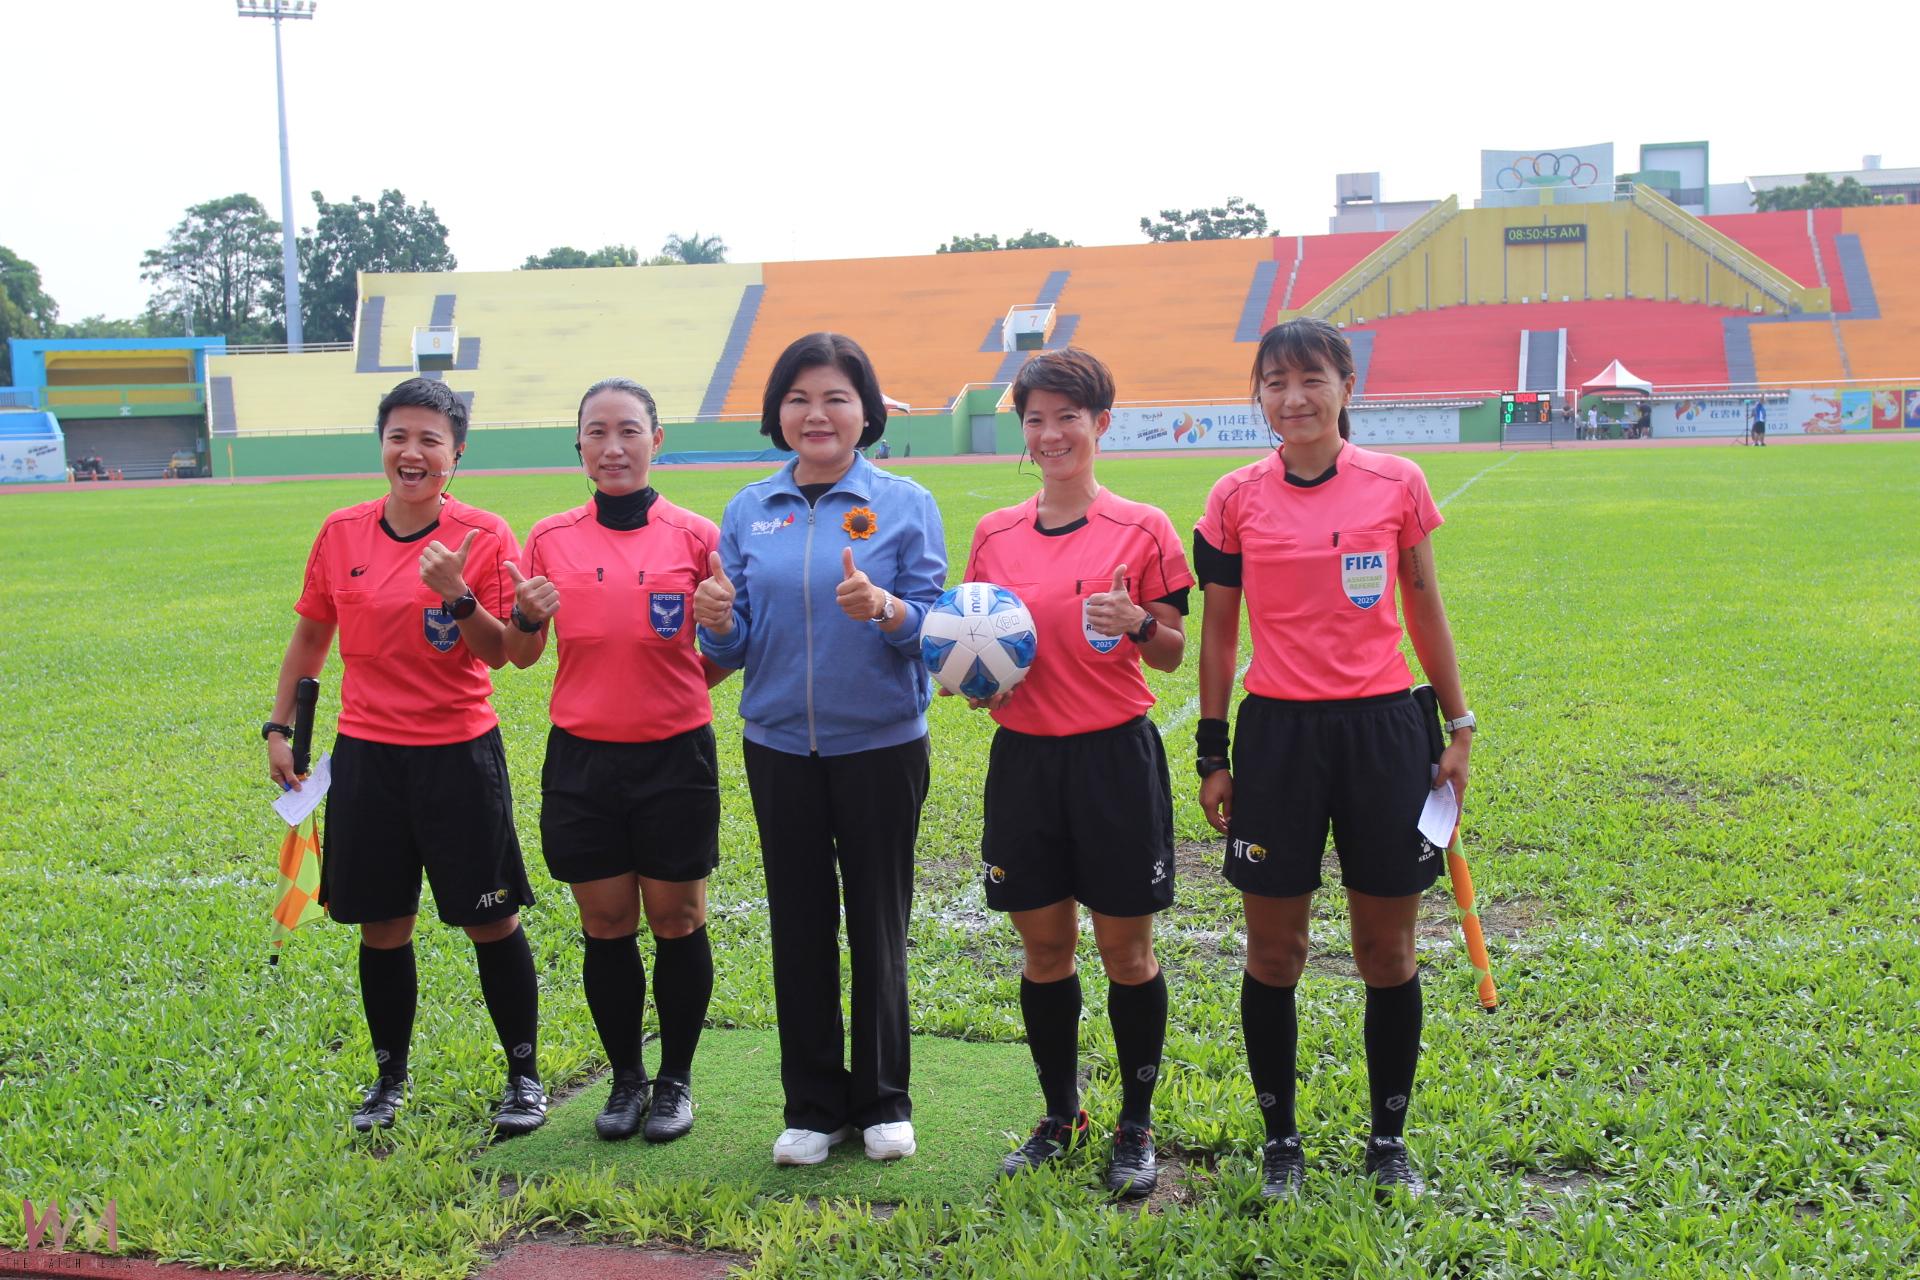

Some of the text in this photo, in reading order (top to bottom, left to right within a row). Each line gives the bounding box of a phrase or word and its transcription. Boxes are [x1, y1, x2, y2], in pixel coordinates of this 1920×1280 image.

[1508, 226, 1580, 241] 08:50:45 AM
[432, 336, 441, 349] 8
[1767, 423, 1789, 431] 10.23
[1217, 429, 1258, 441] 在雲林
[1345, 555, 1383, 571] FIFA
[1357, 596, 1375, 605] 2025
[475, 889, 507, 910] AFC
